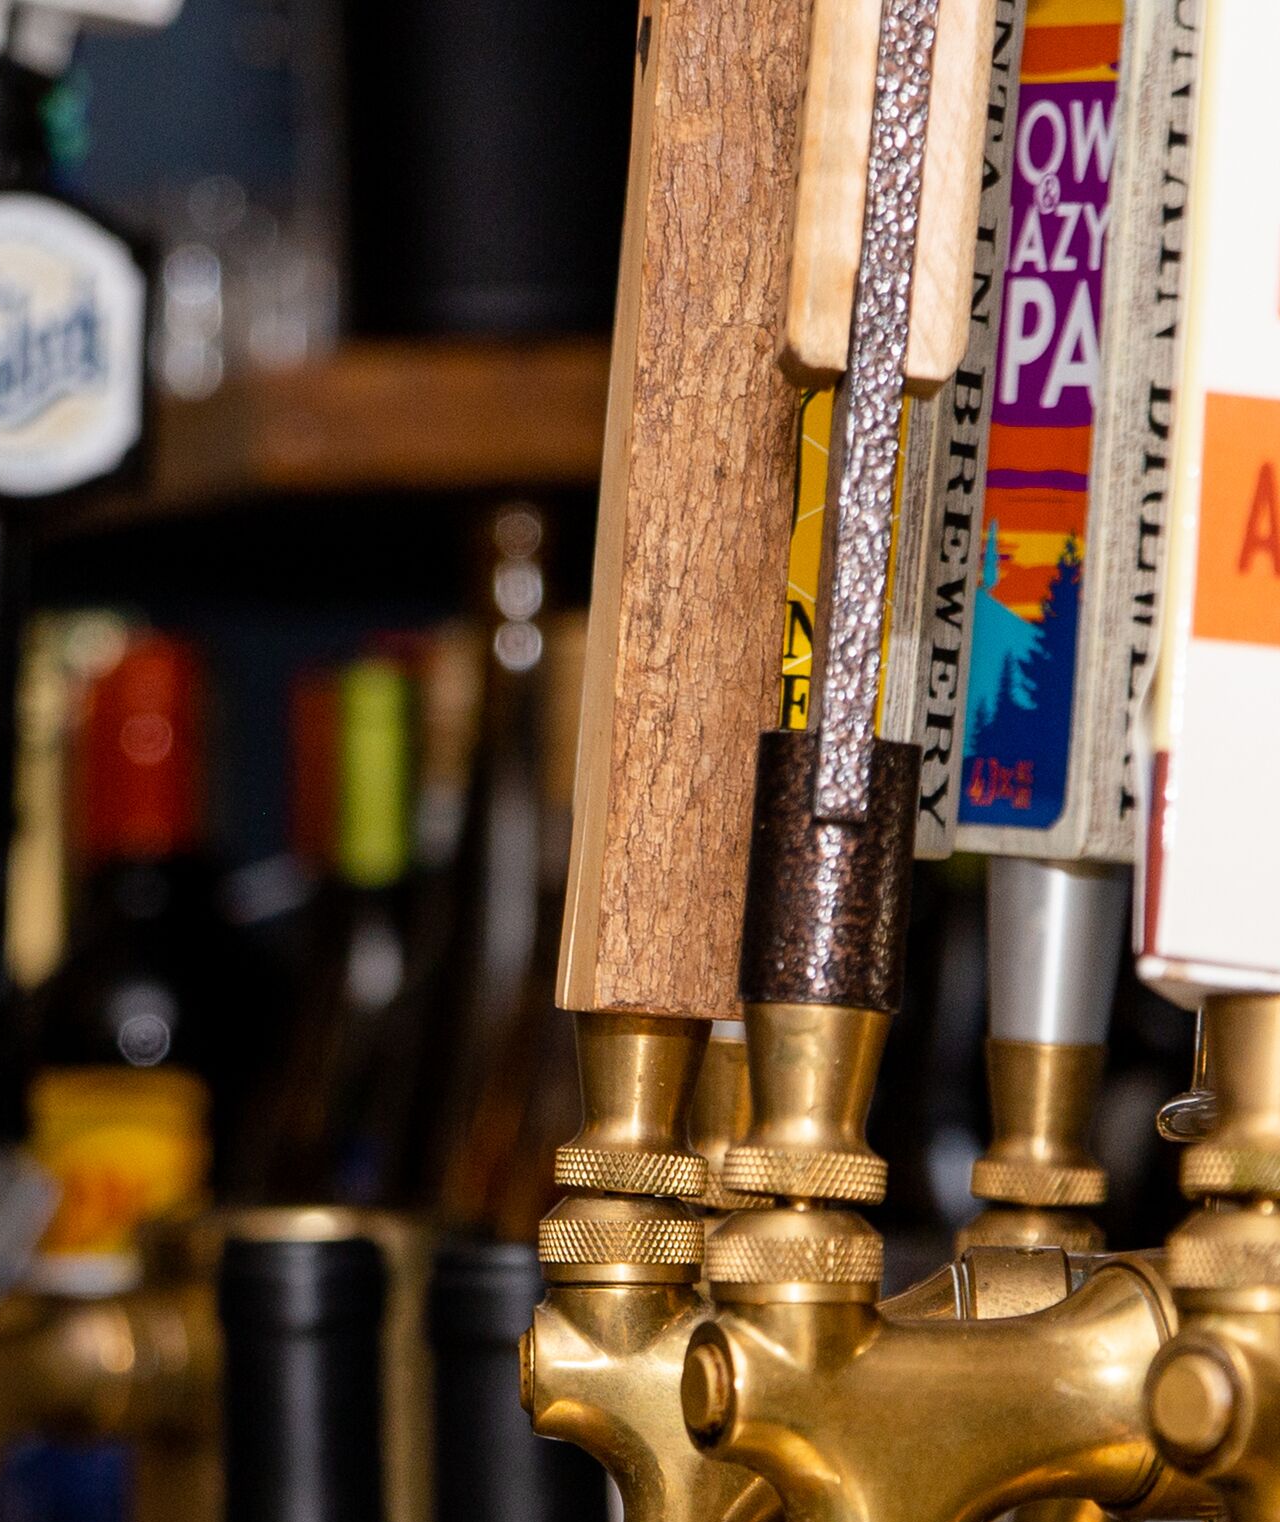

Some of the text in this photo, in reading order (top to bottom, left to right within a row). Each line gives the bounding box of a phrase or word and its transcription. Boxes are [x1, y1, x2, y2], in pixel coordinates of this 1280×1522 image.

[919, 0, 1017, 829] NTAIN BREWERY
[1005, 202, 1112, 273] AZY
